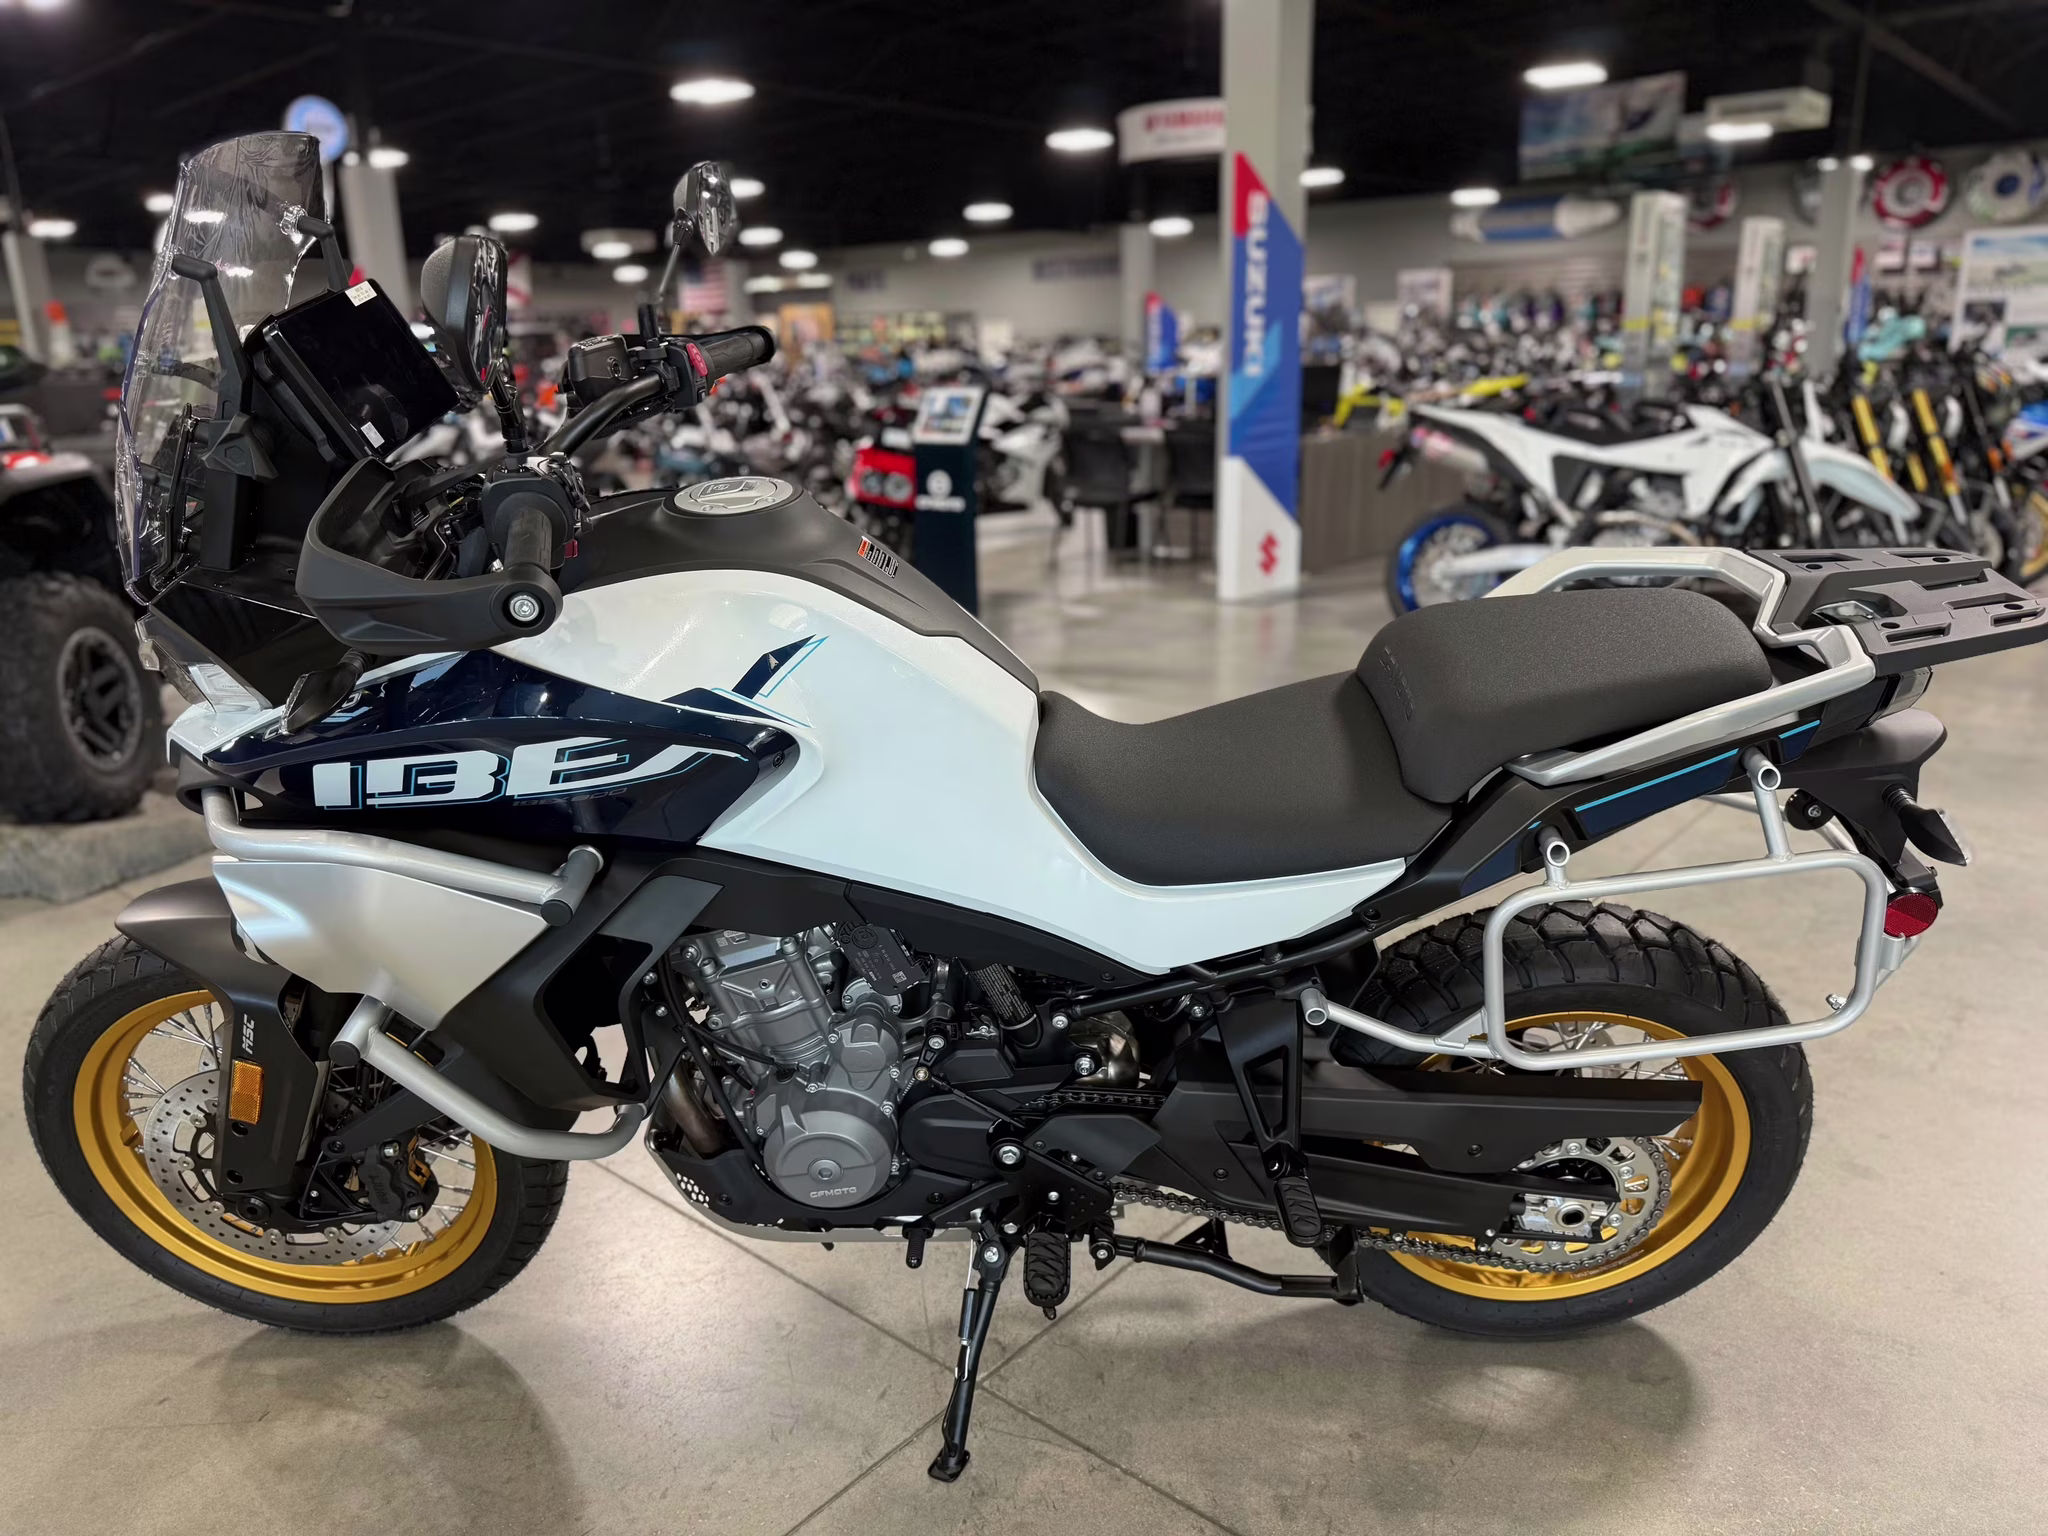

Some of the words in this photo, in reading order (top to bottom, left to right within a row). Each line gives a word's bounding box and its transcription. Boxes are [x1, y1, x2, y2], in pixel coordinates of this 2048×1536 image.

[1244, 188, 1269, 377] SUZUKI
[242, 1013, 255, 1055] MSC
[809, 1186, 858, 1198] CFMOTO
